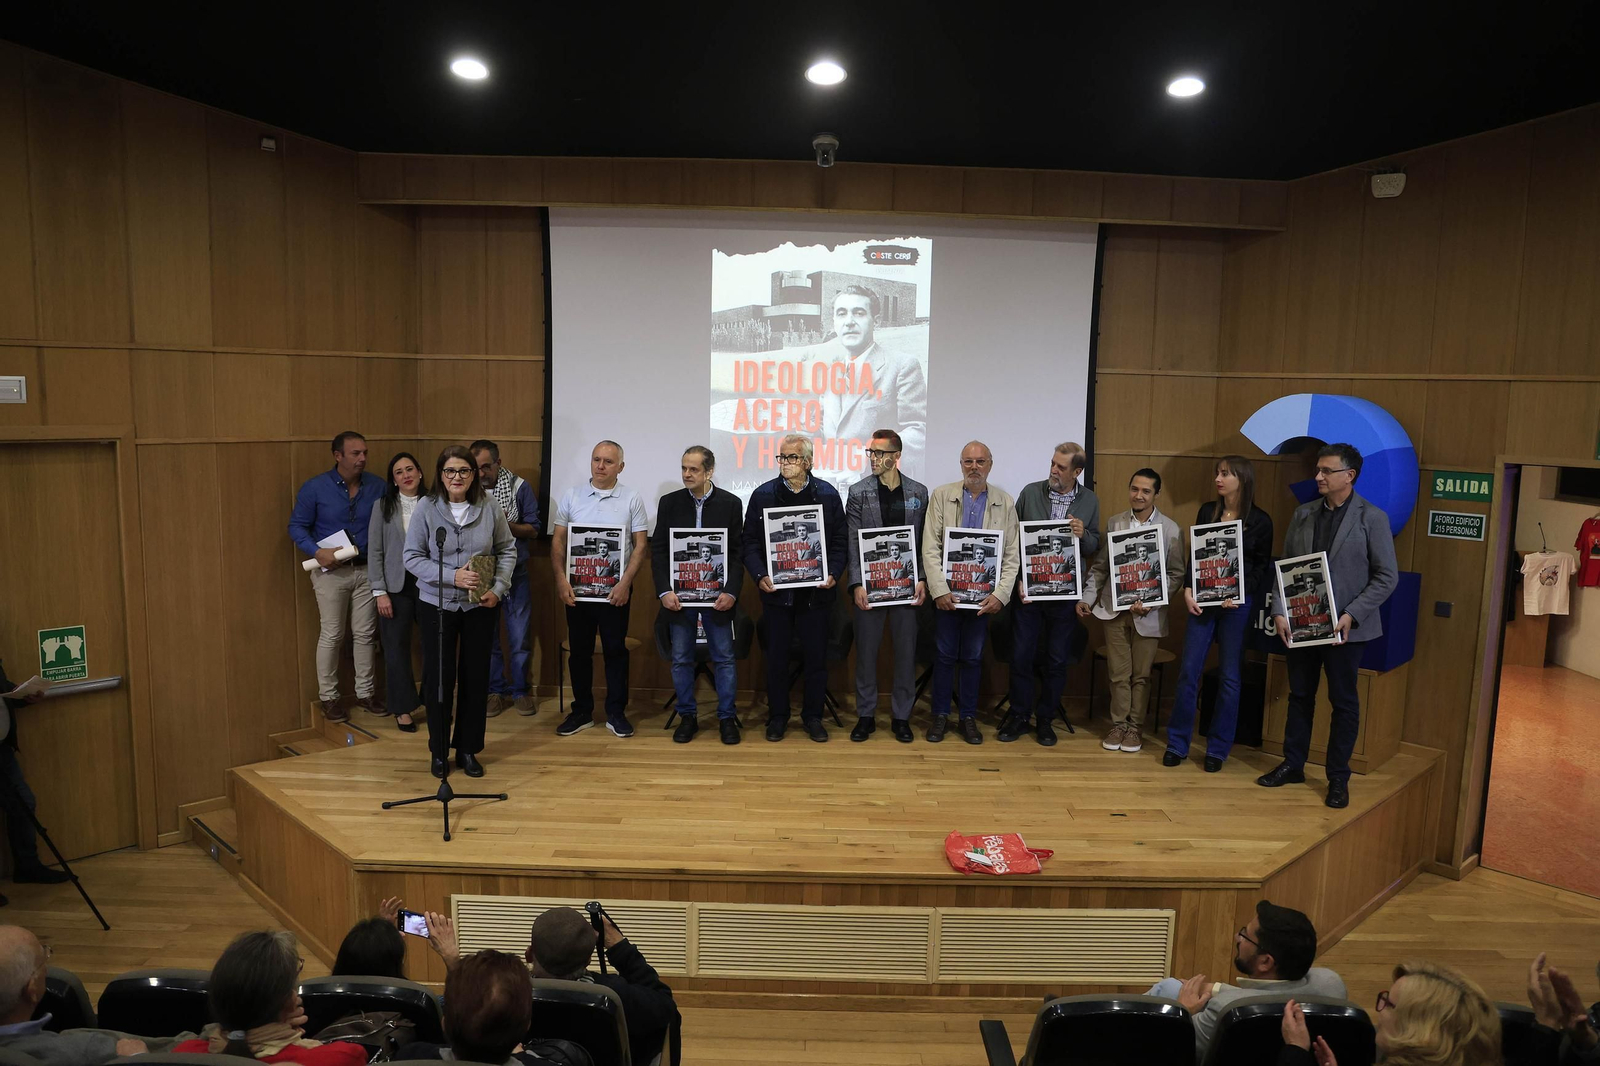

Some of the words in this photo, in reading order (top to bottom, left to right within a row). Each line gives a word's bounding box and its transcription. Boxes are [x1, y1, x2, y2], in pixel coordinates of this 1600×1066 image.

[734, 356, 882, 400] IDEOLOGÍA,
[733, 398, 822, 432] ACERO
[732, 435, 749, 470] Y
[1436, 478, 1489, 494] SALIDA
[1434, 515, 1454, 524] AFORO
[1456, 517, 1480, 526] EDIFICIO
[1446, 526, 1477, 536] PERSONAS
